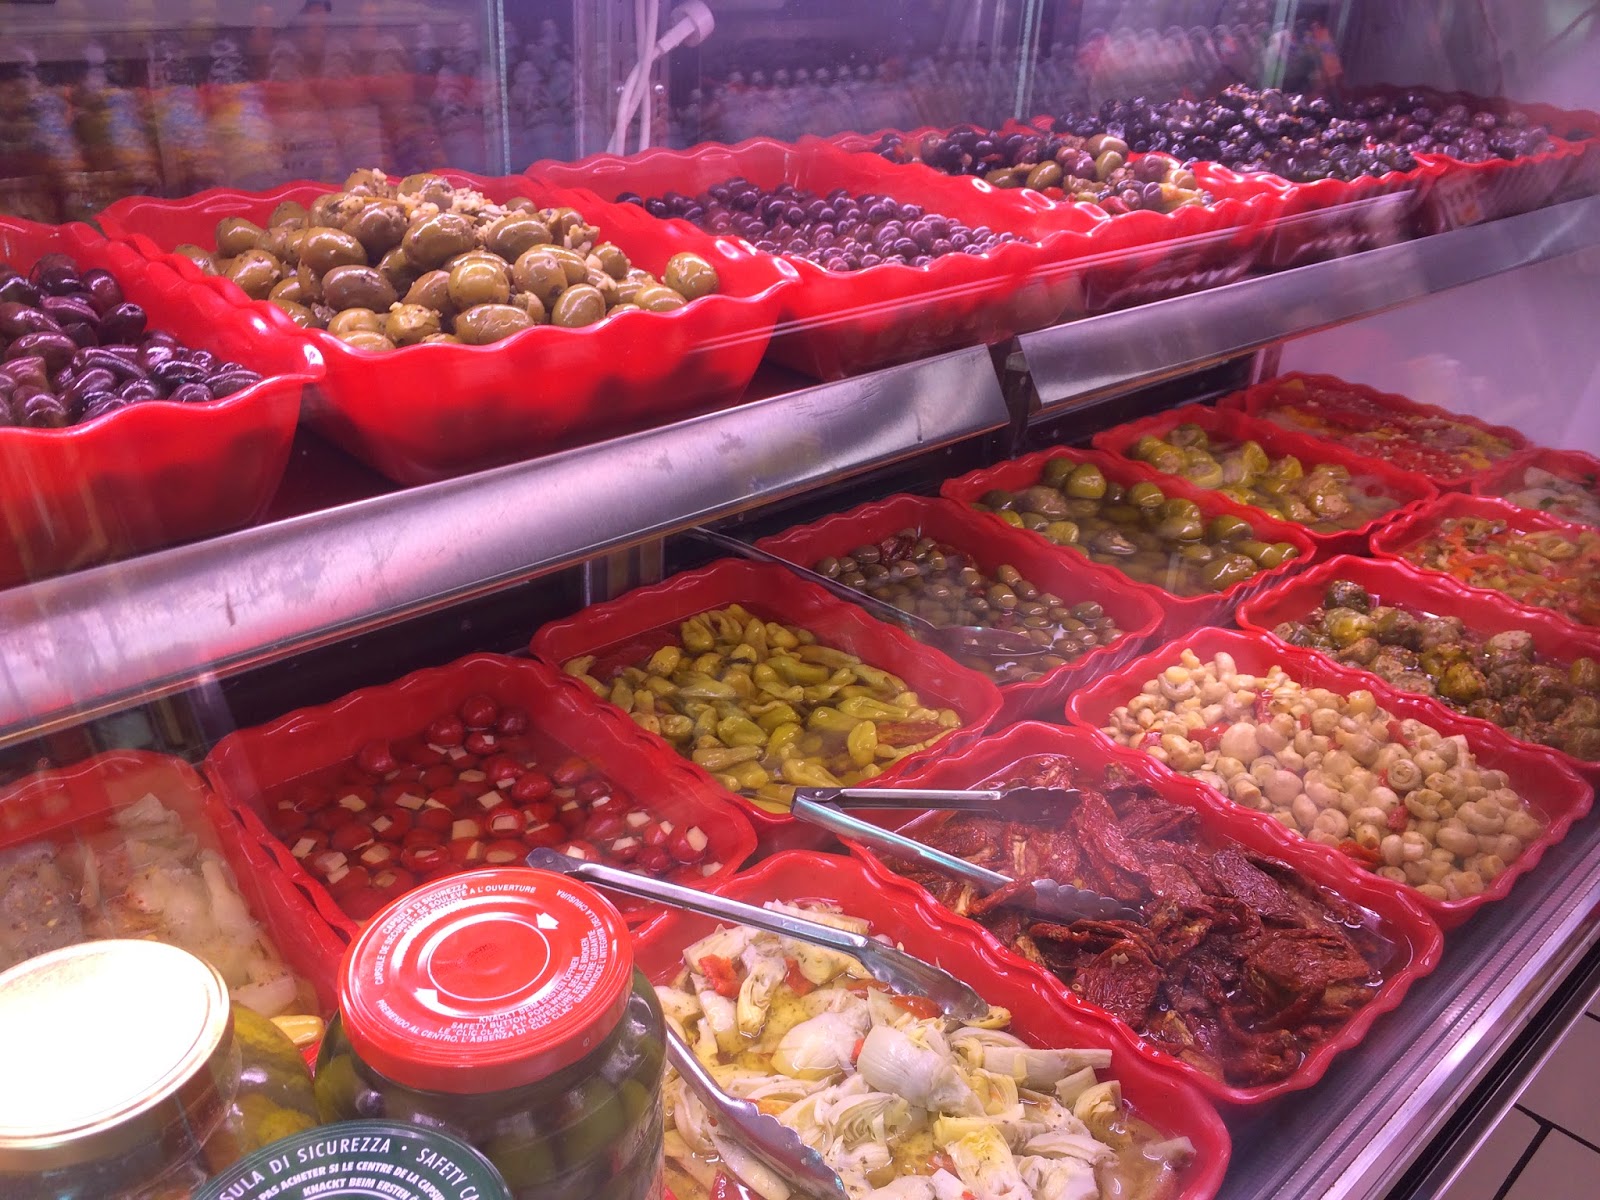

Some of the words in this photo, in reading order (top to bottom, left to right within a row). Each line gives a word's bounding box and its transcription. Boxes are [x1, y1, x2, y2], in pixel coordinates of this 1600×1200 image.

[421, 883, 468, 904] SICUREZZA
[379, 944, 390, 955] DE
[580, 937, 590, 963] BROKEN
[588, 929, 599, 960] GARANTIE
[374, 954, 386, 985] CAPSULE
[375, 999, 410, 1029] PREMENDO
[408, 1025, 420, 1035] AL
[516, 1028, 527, 1036] DI
[556, 889, 589, 912] CHIUSURA
[578, 963, 588, 971] IS
[582, 961, 597, 981] VOTRE
[567, 971, 584, 988] SEAL
[573, 980, 587, 994] EST
[478, 1009, 517, 1023] KNACKT
[518, 1001, 541, 1015] BEIM
[541, 980, 566, 1003] ERSTEN
[549, 988, 571, 1006] WHEN
[528, 1003, 552, 1018] POPS
[438, 1026, 451, 1035] LE
[451, 1021, 490, 1030] SAFETY
[489, 1015, 527, 1029] BUTTON
[268, 1155, 291, 1175] DI
[296, 1136, 391, 1163] SICUREZZA
[415, 1147, 468, 1187] SAFETY
[257, 1185, 280, 1200] PAS
[280, 1165, 327, 1191] ACHETER
[328, 1162, 340, 1174] SI
[341, 1161, 355, 1172] LE
[355, 1160, 395, 1175] CENTRE
[392, 1166, 408, 1179] DE
[405, 1170, 420, 1185] LA
[302, 1178, 347, 1197] KNACKT
[348, 1177, 377, 1188] BEIM
[375, 1179, 411, 1200] ERSTEN
